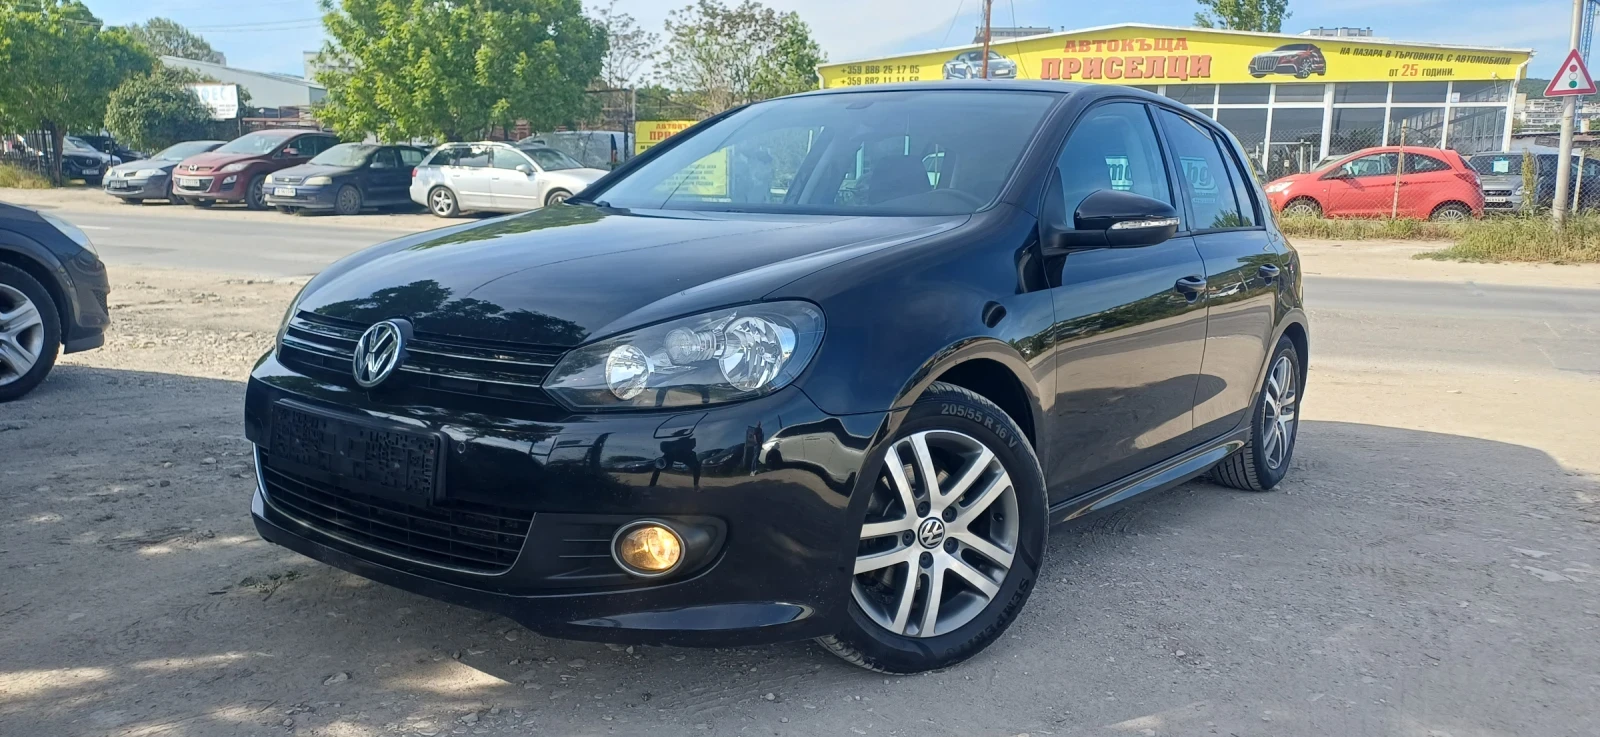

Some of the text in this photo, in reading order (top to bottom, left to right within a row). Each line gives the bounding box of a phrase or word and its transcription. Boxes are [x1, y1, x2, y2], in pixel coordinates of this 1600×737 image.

[1063, 37, 1189, 53] АВТОКЪЩА
[1340, 47, 1512, 66] НА ПАЗАРА В ТЪРГОВИЯТА С АВТОМОБИЛИ
[840, 65, 863, 75] +359
[883, 65, 894, 74] 25
[896, 65, 907, 74] 17
[909, 64, 921, 74] 05
[1039, 54, 1213, 81] ПРИСЕЛЦИ
[1388, 63, 1455, 78] ОТ 25 ГОДИНИ.
[840, 76, 862, 86] +359
[941, 403, 1018, 449] 205/55 R 16 V
